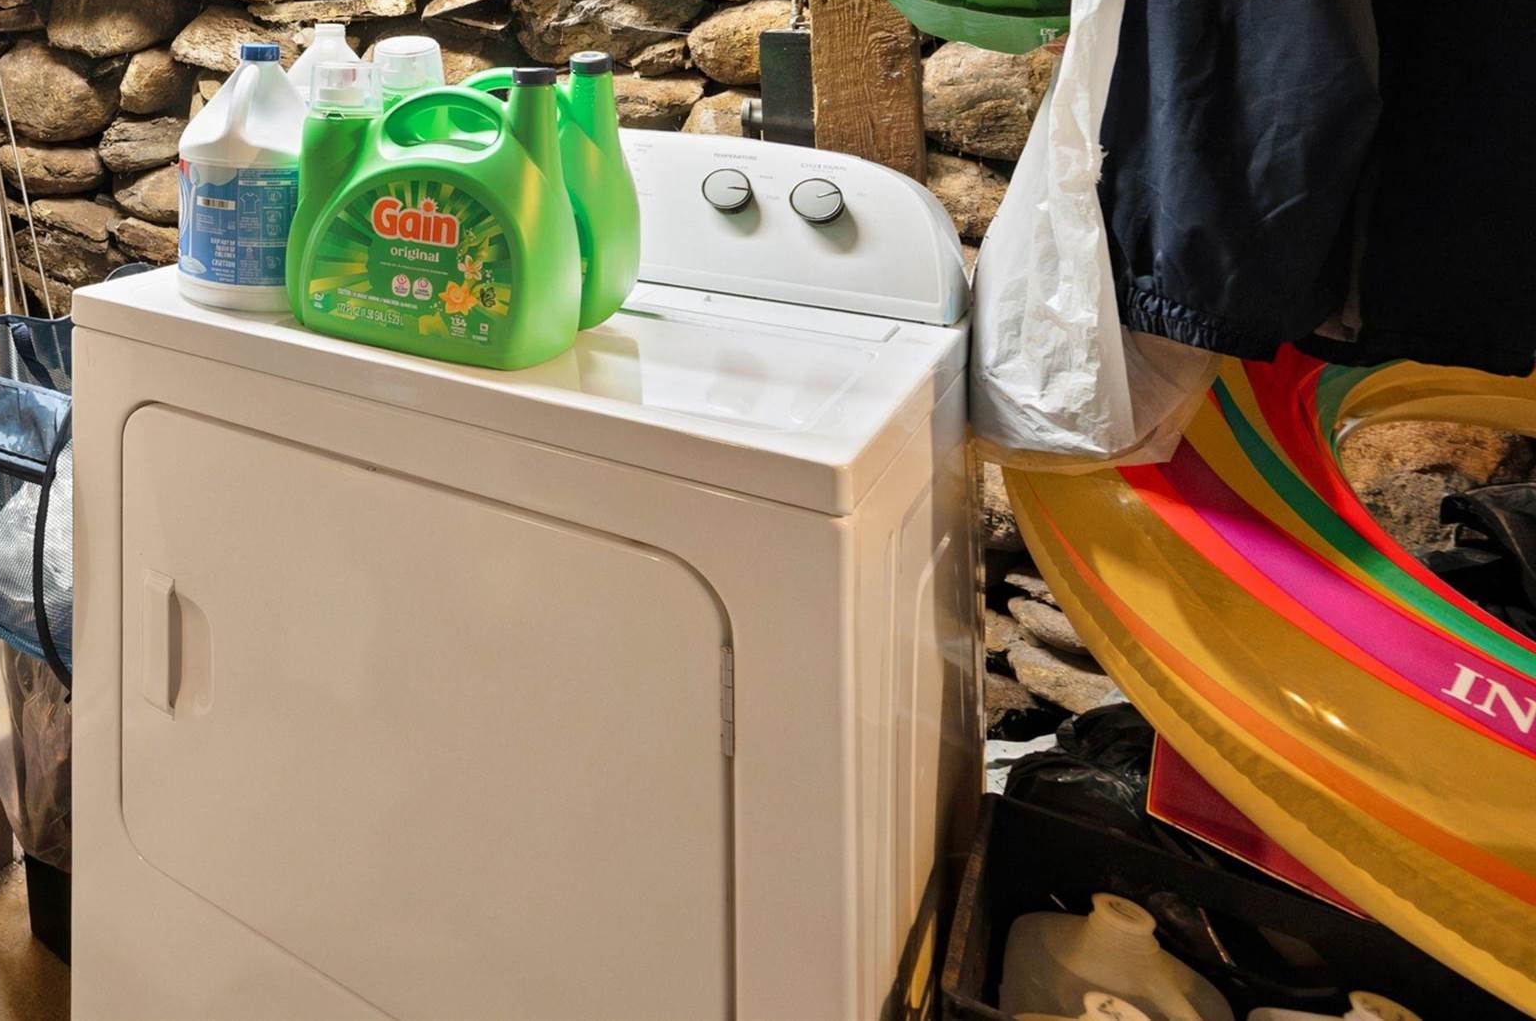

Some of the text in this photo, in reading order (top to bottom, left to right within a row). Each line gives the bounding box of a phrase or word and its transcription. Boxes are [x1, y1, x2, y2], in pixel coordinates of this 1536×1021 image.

[372, 197, 459, 248] Gain
[390, 246, 440, 263] original
[1440, 662, 1536, 734] IN
